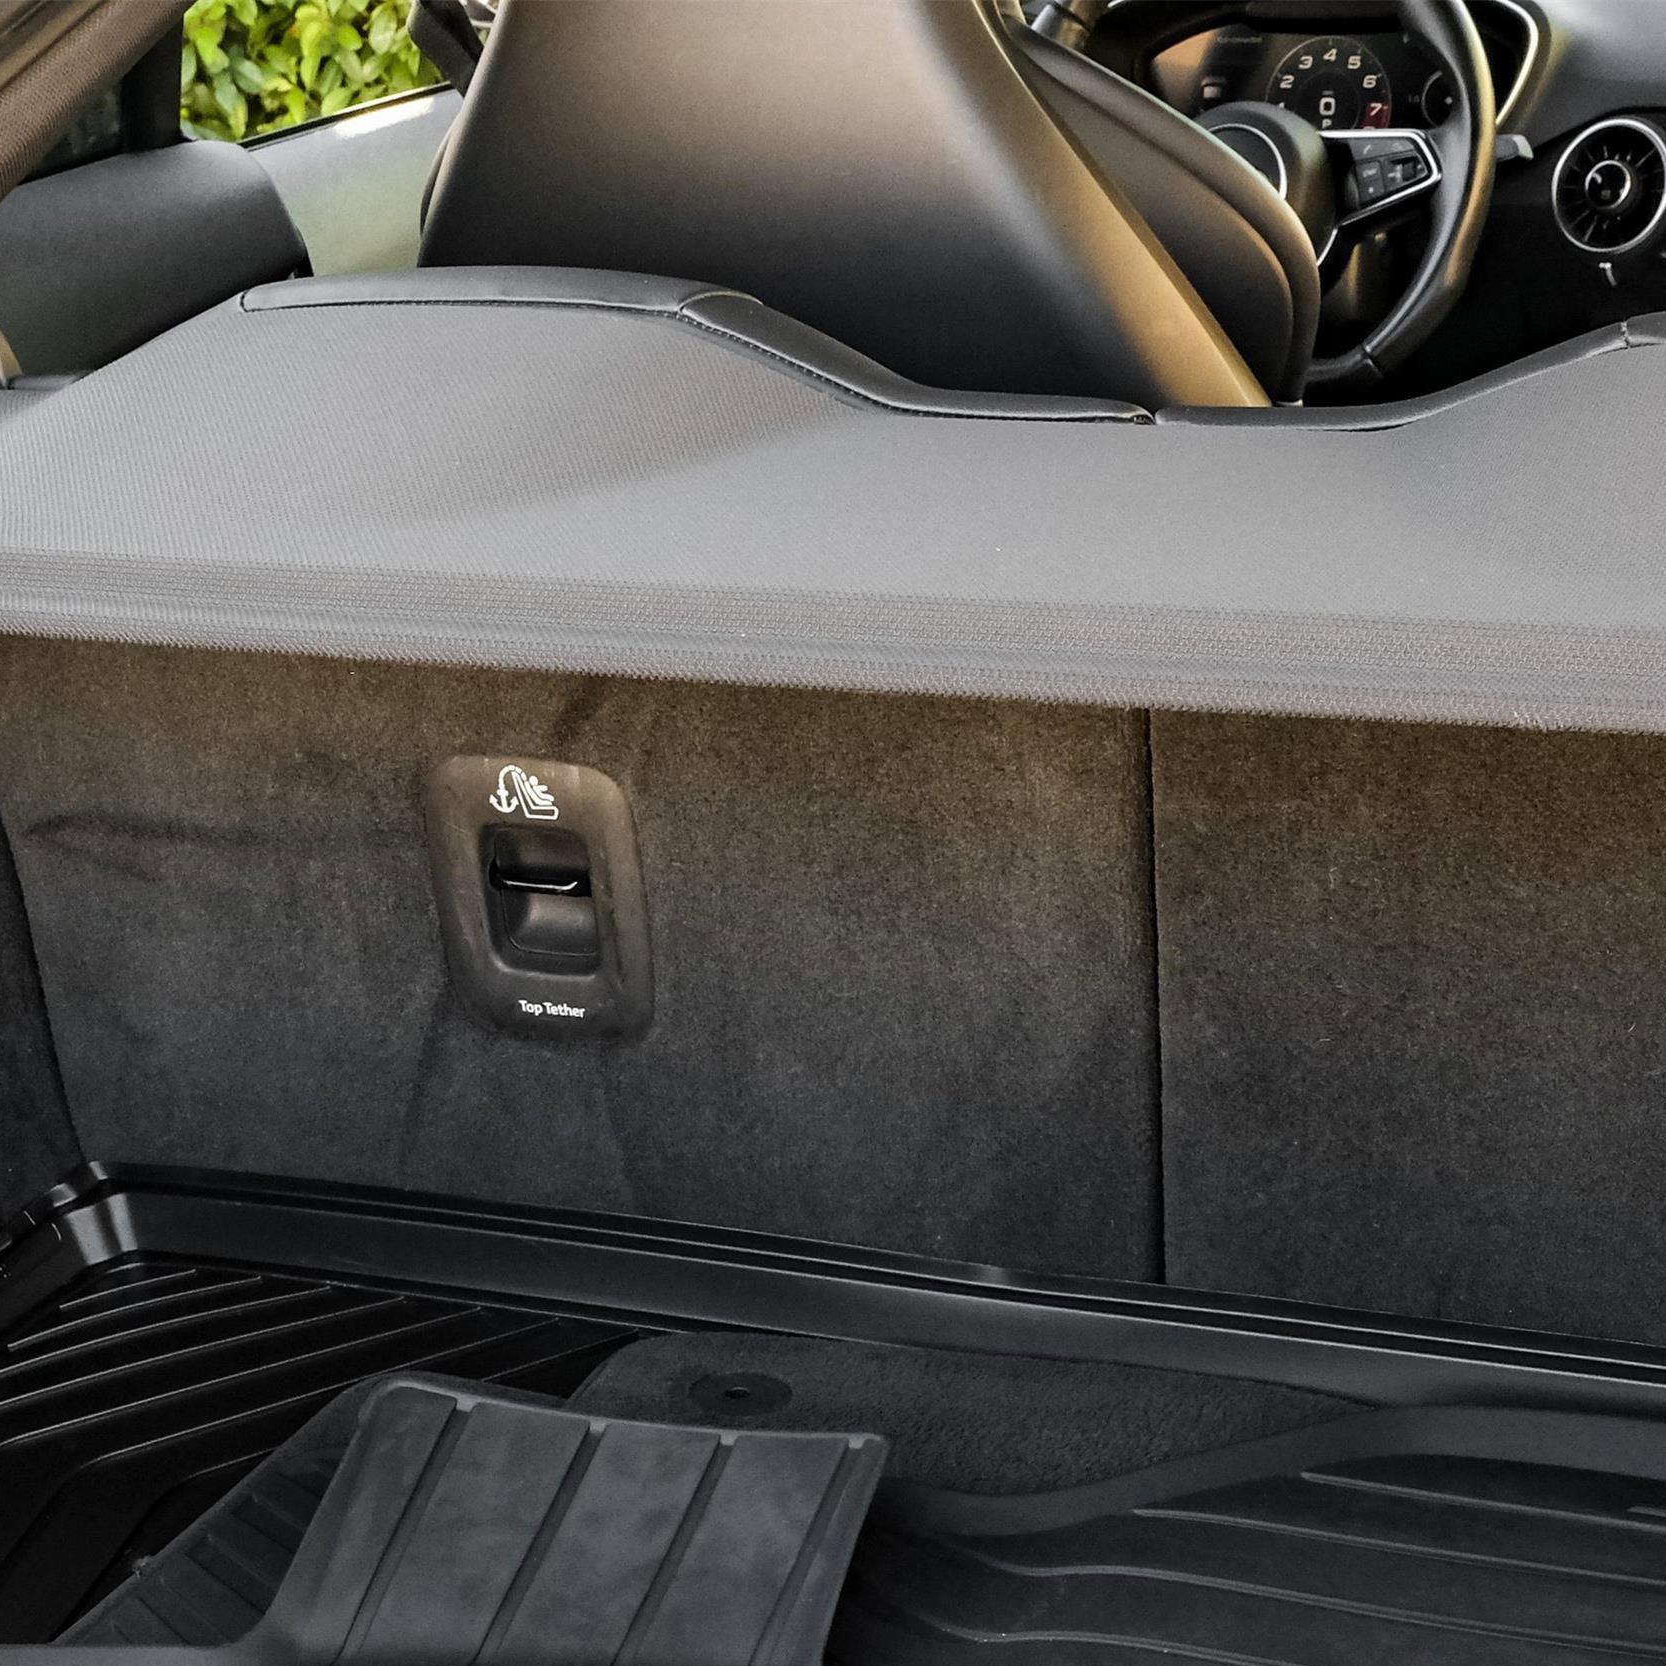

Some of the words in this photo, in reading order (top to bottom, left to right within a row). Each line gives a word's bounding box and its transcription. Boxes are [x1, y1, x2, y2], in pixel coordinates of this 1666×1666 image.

[1323, 48, 1337, 61] 4
[1298, 55, 1313, 69] 3
[1347, 55, 1361, 69] 5
[1279, 74, 1295, 88] 2
[1362, 74, 1377, 88] 6
[1370, 103, 1382, 116] 7
[518, 1000, 543, 1016] Top
[542, 1002, 585, 1018] Tether
